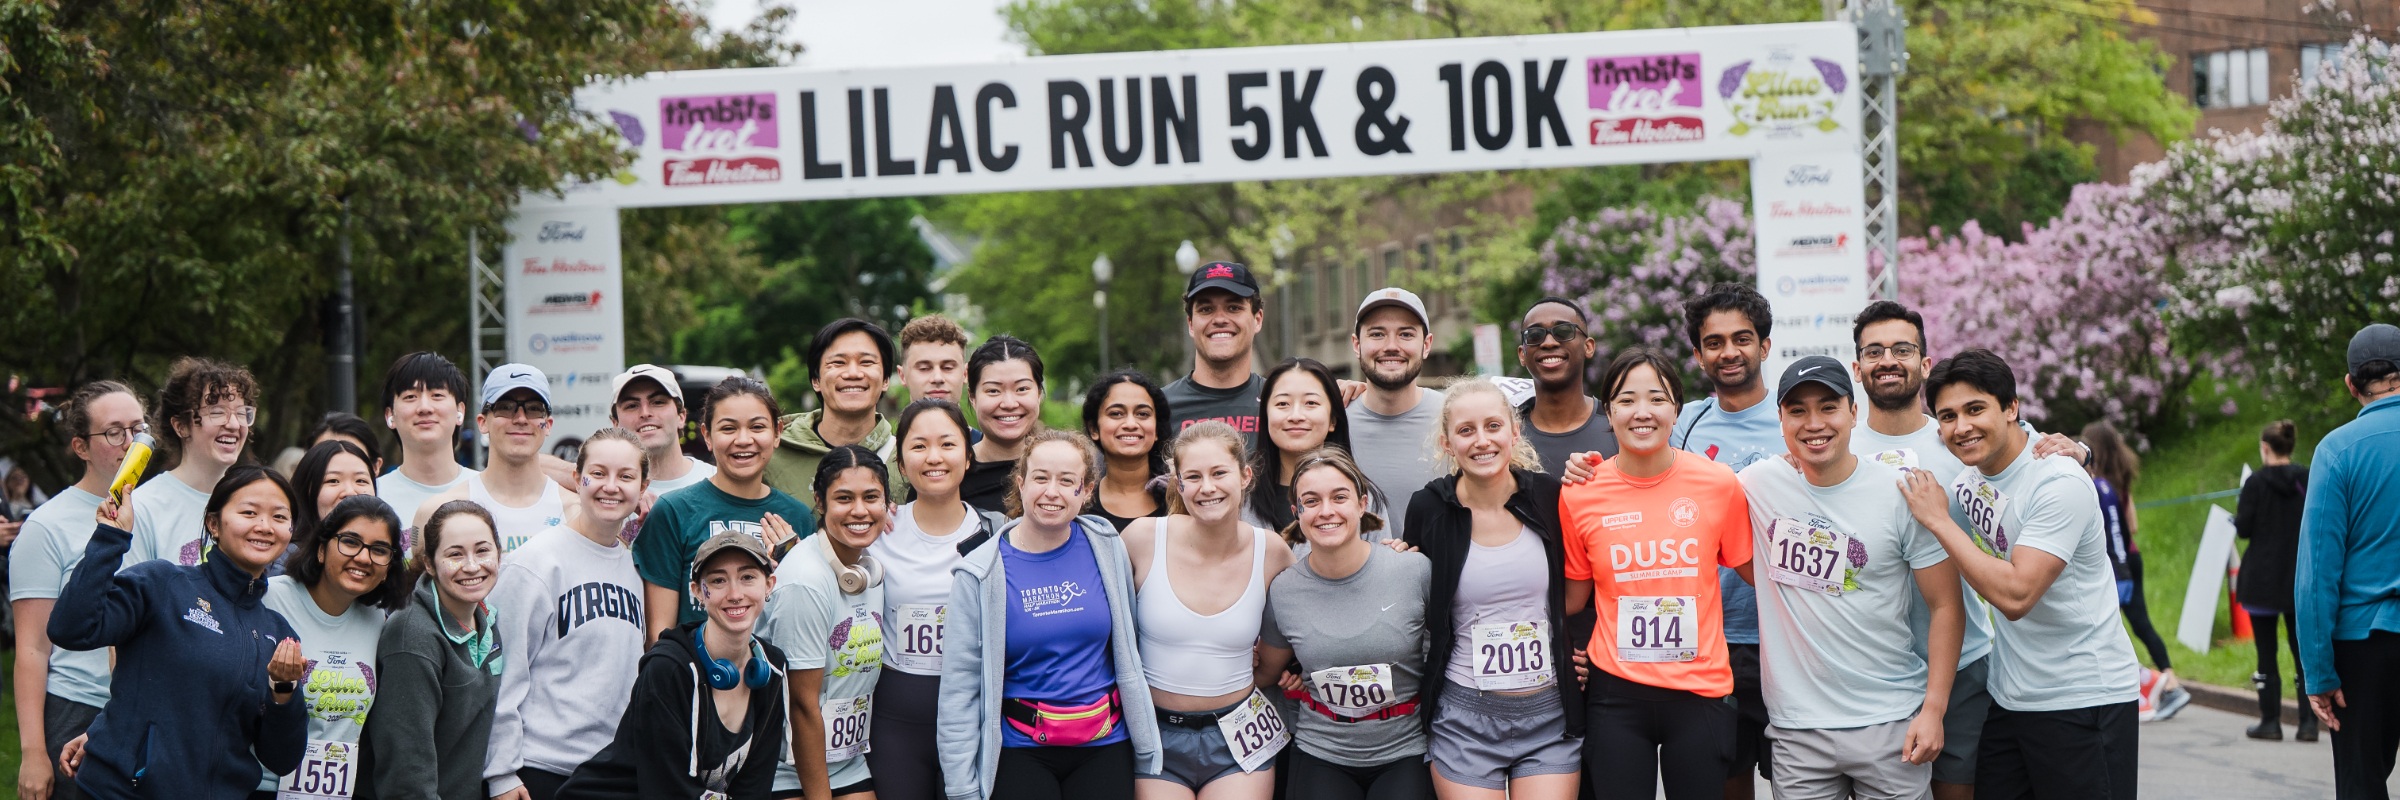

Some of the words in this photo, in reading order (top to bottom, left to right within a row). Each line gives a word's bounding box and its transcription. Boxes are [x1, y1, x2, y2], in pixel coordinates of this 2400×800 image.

[1592, 55, 1695, 85] timbits
[666, 95, 772, 125] timbits
[799, 82, 1019, 179] LILAC
[1048, 76, 1200, 169] RUN
[1227, 68, 1329, 161] 5K
[1354, 65, 1413, 156] &
[1438, 58, 1573, 152] 10K
[1610, 538, 1699, 570] DUSC
[1778, 538, 1839, 580] 1637
[1630, 571, 1660, 579] SUMMER
[1021, 585, 1059, 597] TORONTO
[1022, 593, 1060, 603] MARATHON
[558, 581, 646, 640] VIRGIN
[1631, 616, 1683, 648] 914
[327, 655, 346, 665] Ford
[1482, 640, 1543, 674] 2013
[307, 669, 366, 695] Lilac
[1321, 683, 1386, 707] 1780
[314, 693, 357, 713] Run
[832, 712, 866, 748] 898
[1234, 704, 1282, 758] 1398
[289, 760, 349, 796] 1551
